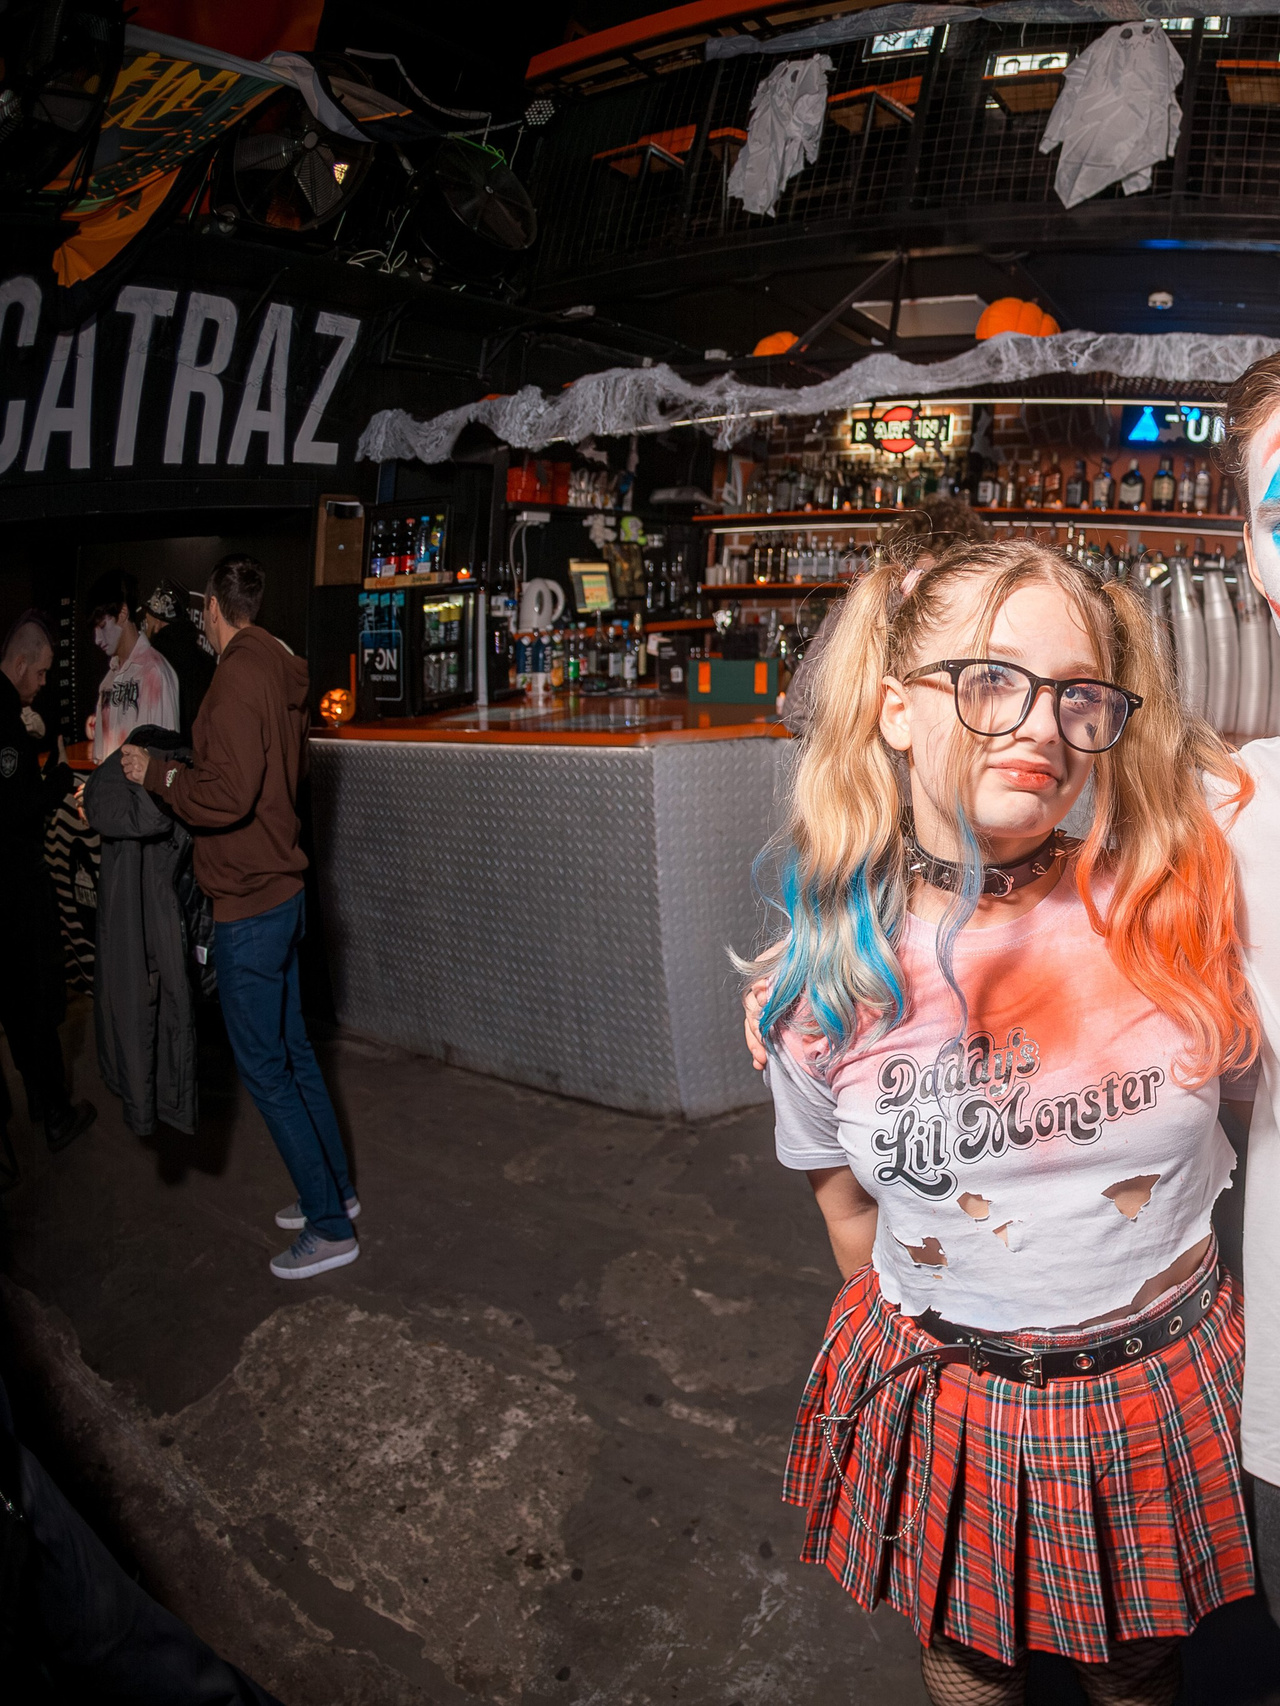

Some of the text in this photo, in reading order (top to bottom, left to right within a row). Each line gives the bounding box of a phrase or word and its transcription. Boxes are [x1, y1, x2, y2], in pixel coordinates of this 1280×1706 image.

[876, 1027, 1040, 1114] Daddy's
[871, 1066, 1165, 1201] Lil Monster
